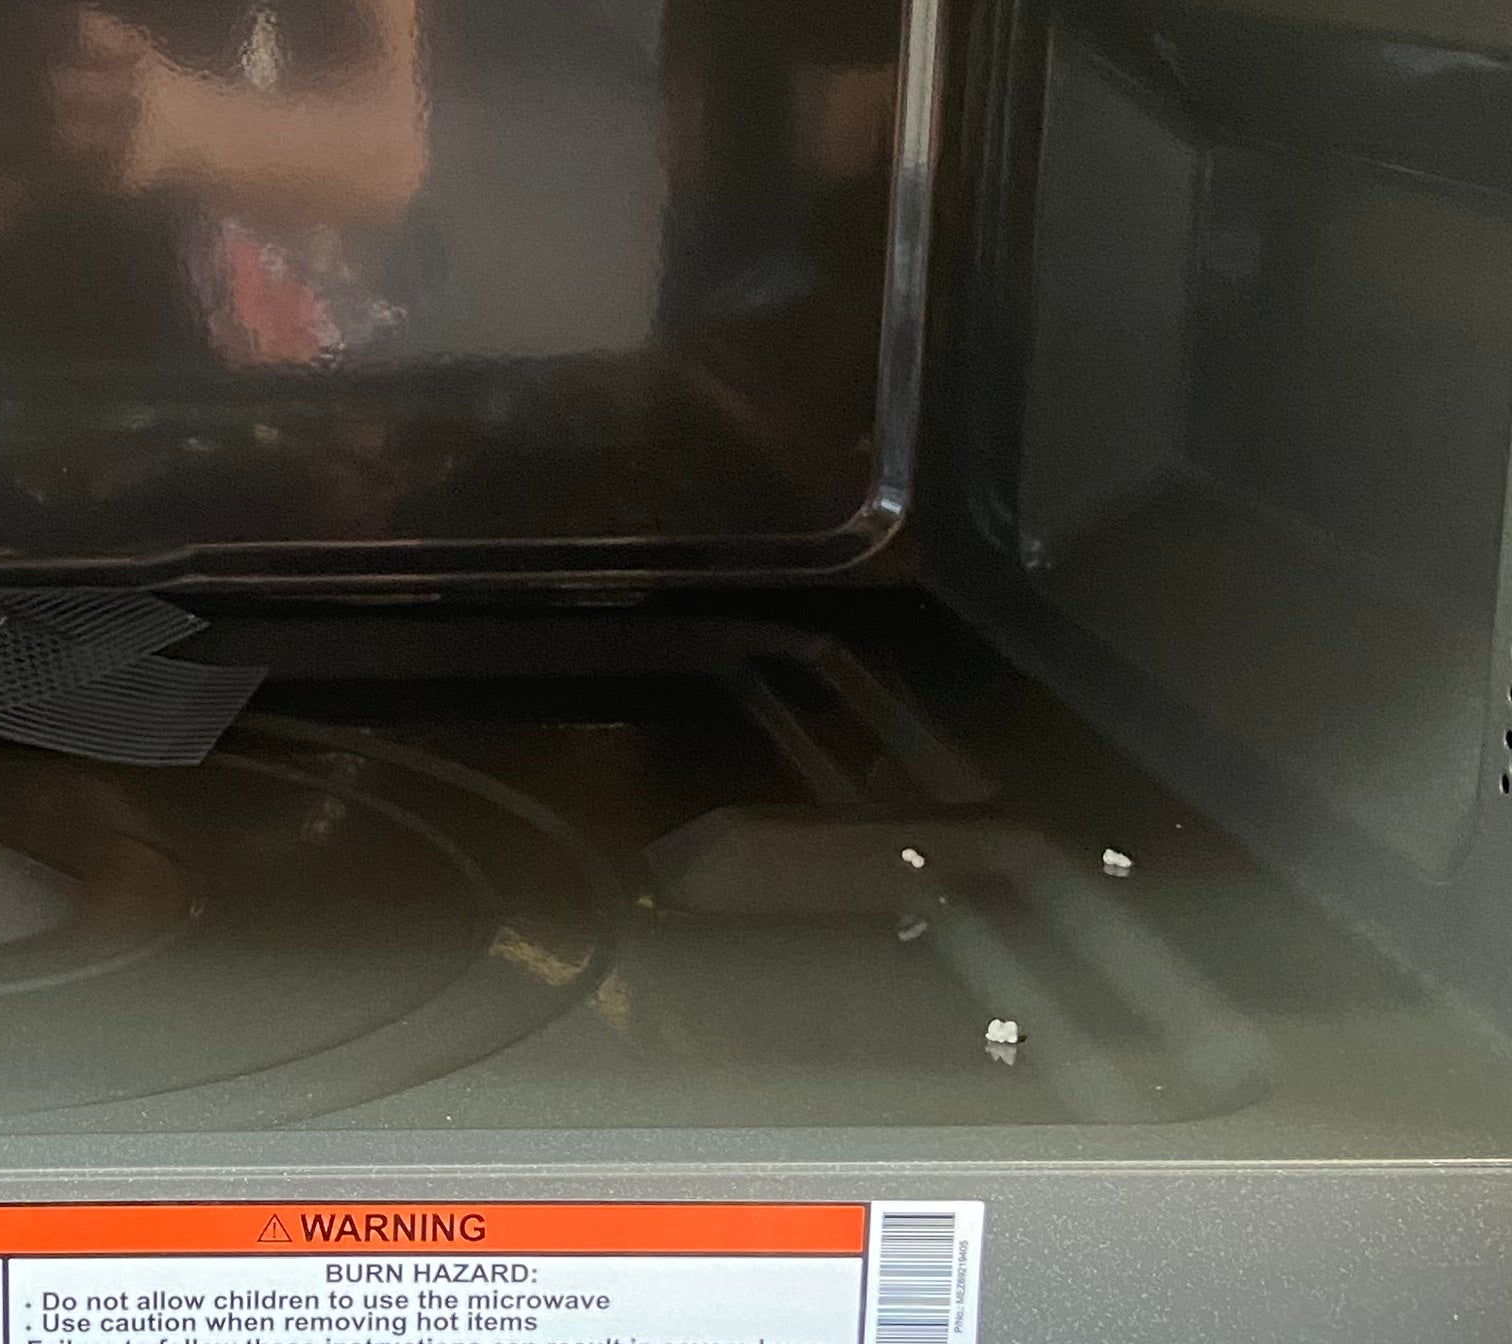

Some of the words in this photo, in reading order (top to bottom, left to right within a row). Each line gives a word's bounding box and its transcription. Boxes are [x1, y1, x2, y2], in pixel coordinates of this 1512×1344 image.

[300, 1213, 486, 1243] WARNING
[325, 1262, 404, 1284] BURN
[413, 1263, 538, 1284] HAZARD:
[42, 1292, 80, 1311] Do
[87, 1294, 129, 1311] not
[137, 1292, 205, 1311] allow
[214, 1292, 319, 1310] children
[328, 1294, 355, 1310] to
[363, 1296, 409, 1310] use
[417, 1292, 459, 1309] the
[467, 1292, 610, 1310] microwave
[42, 1314, 92, 1333] Use
[101, 1314, 199, 1333] caution
[206, 1314, 275, 1332] when
[285, 1314, 406, 1336] removing
[417, 1314, 459, 1331] hot
[467, 1314, 538, 1331] items
